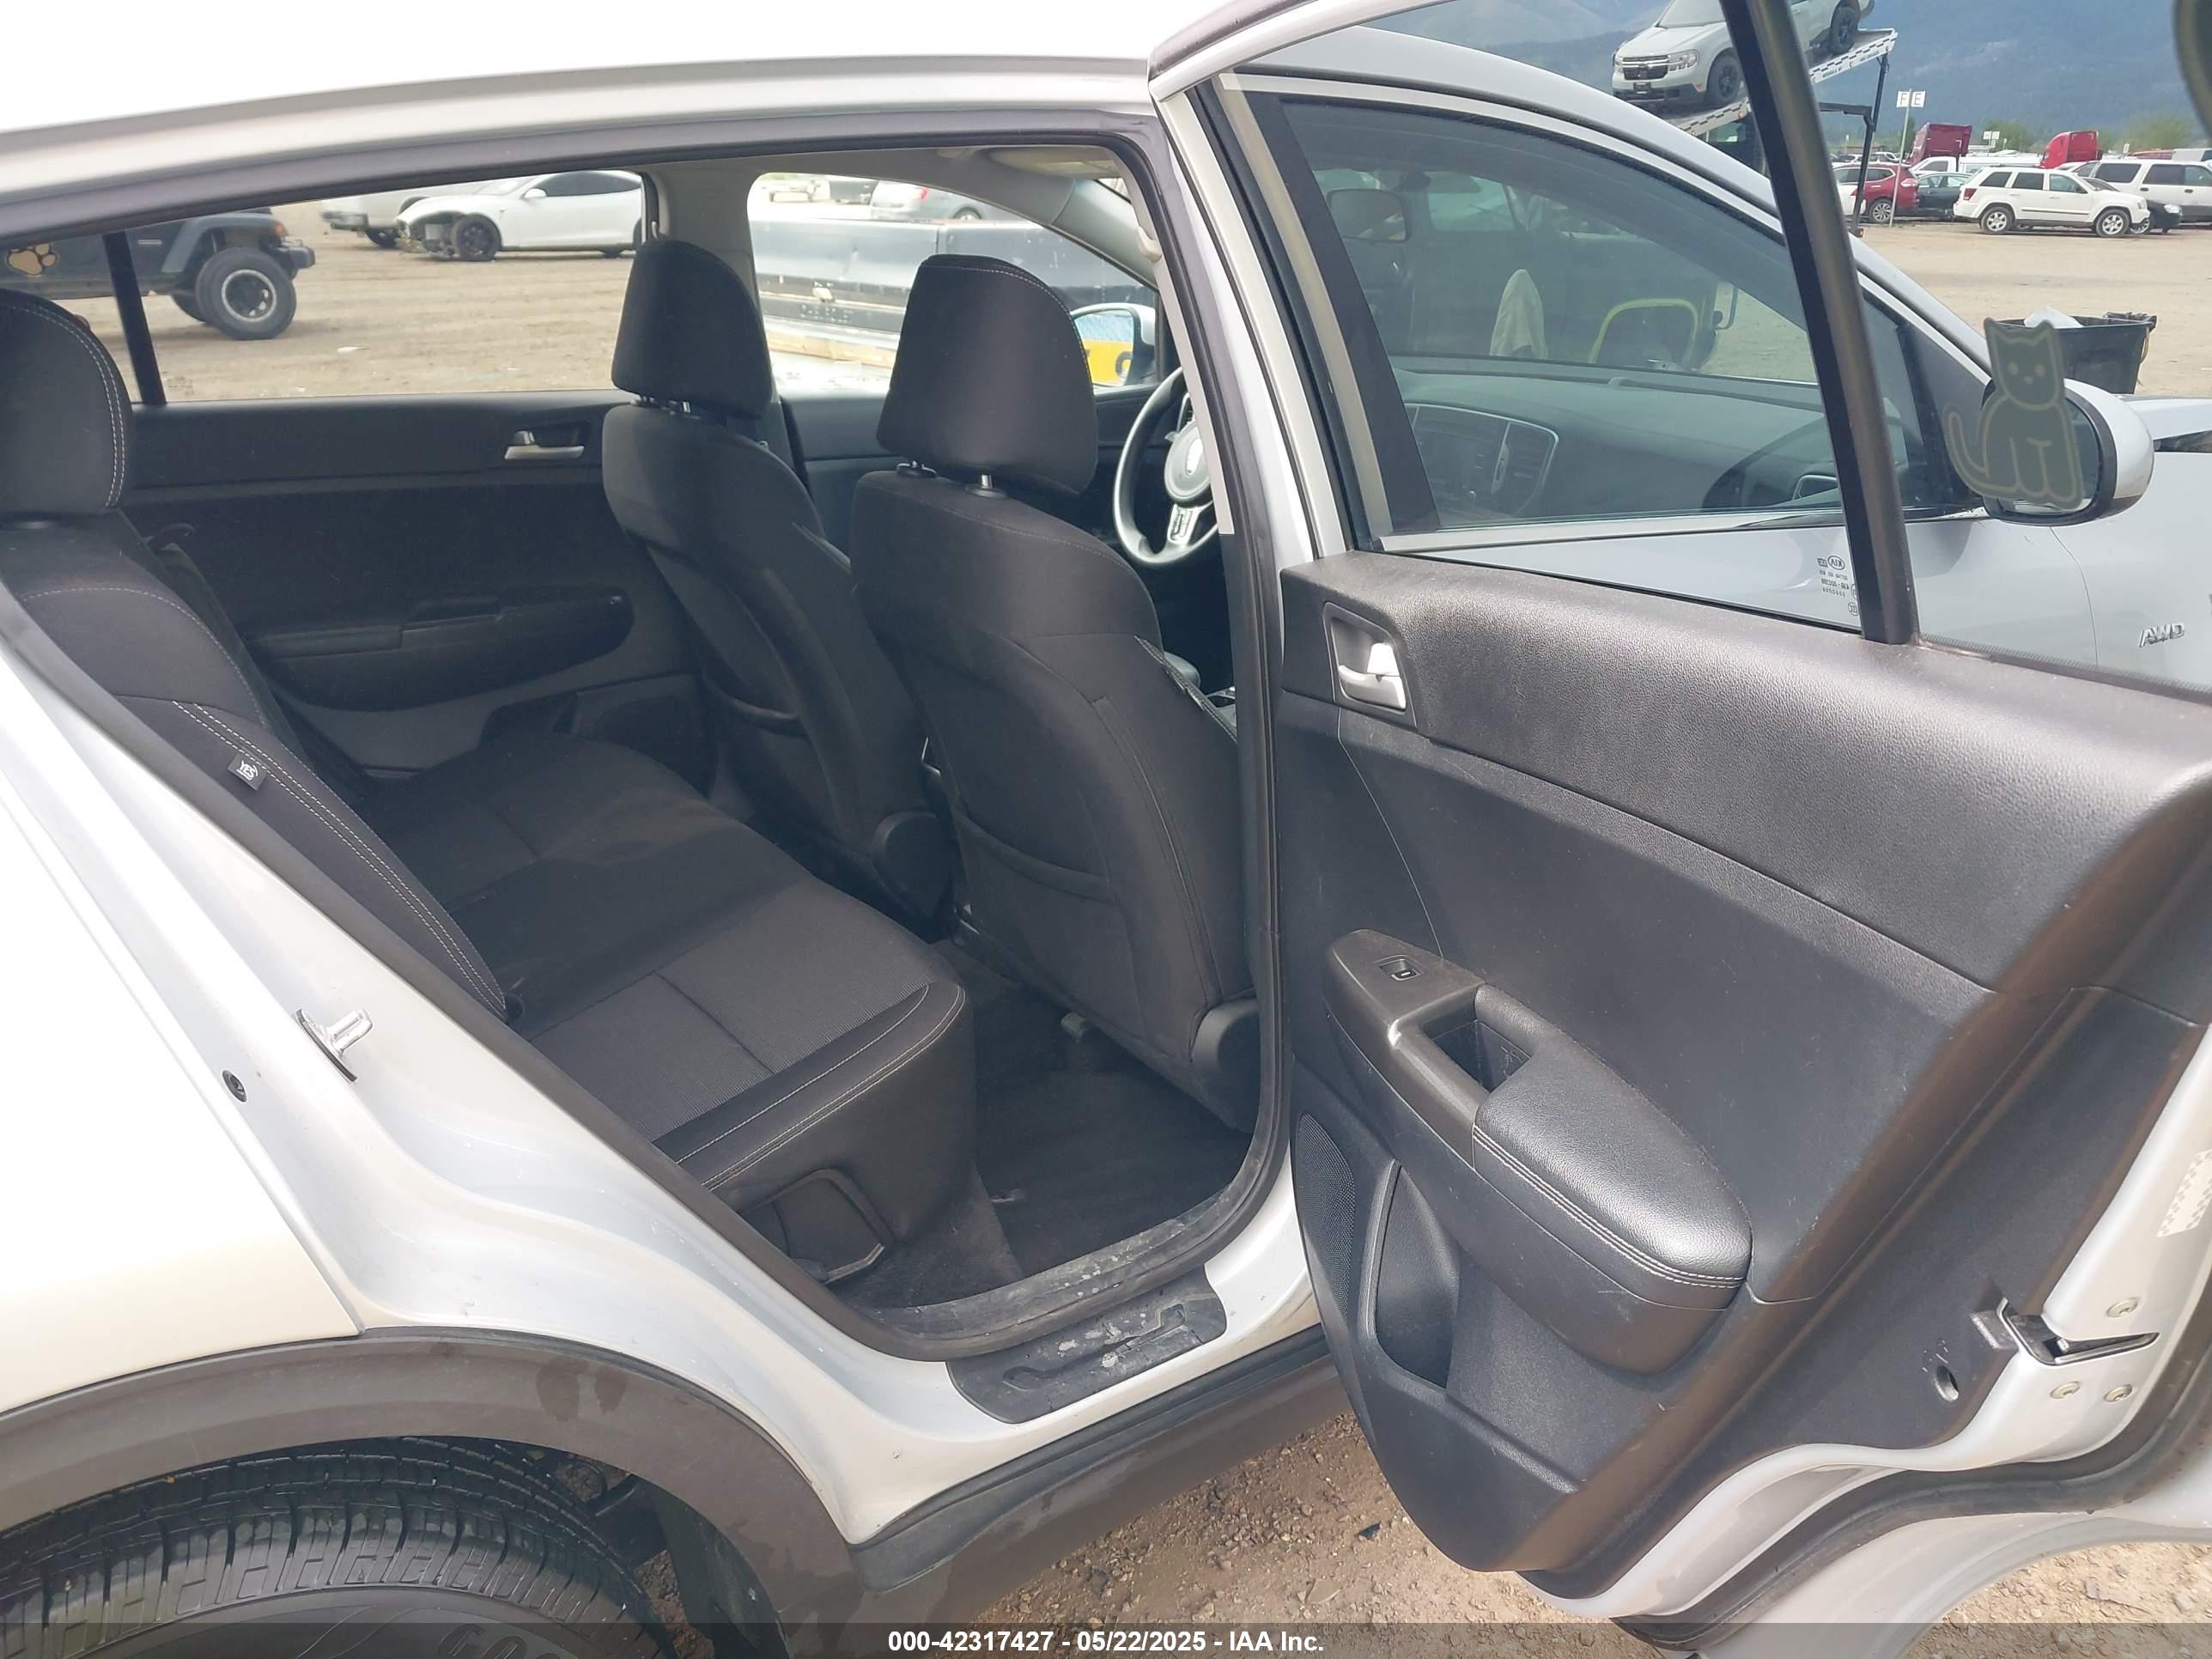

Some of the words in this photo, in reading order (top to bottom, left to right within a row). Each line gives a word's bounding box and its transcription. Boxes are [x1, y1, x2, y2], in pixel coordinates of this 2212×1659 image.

[1914, 93, 1923, 106] E
[2138, 623, 2185, 647] AWD
[239, 759, 256, 779] YES
